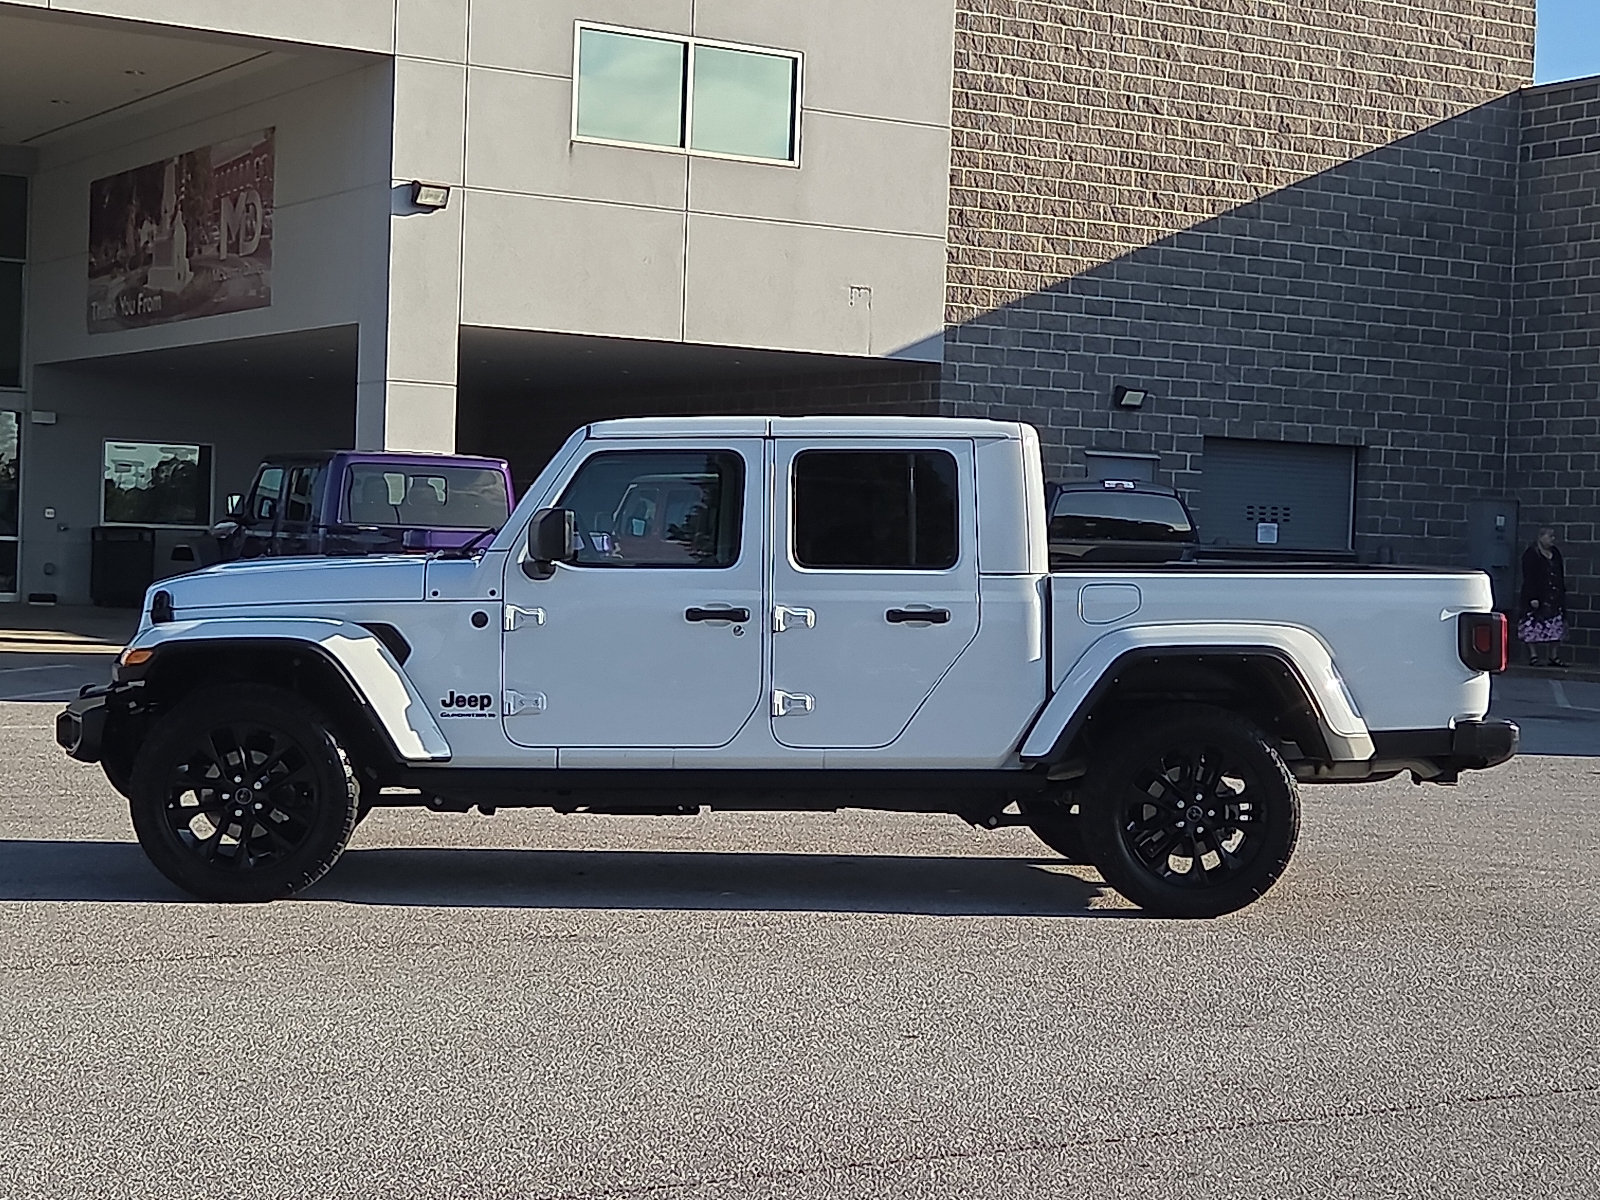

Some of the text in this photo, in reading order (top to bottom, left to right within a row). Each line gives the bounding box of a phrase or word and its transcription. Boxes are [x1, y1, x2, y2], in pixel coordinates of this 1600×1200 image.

[220, 189, 262, 261] MD
[119, 295, 136, 316] You
[138, 293, 162, 314] From
[441, 690, 492, 711] Jeep
